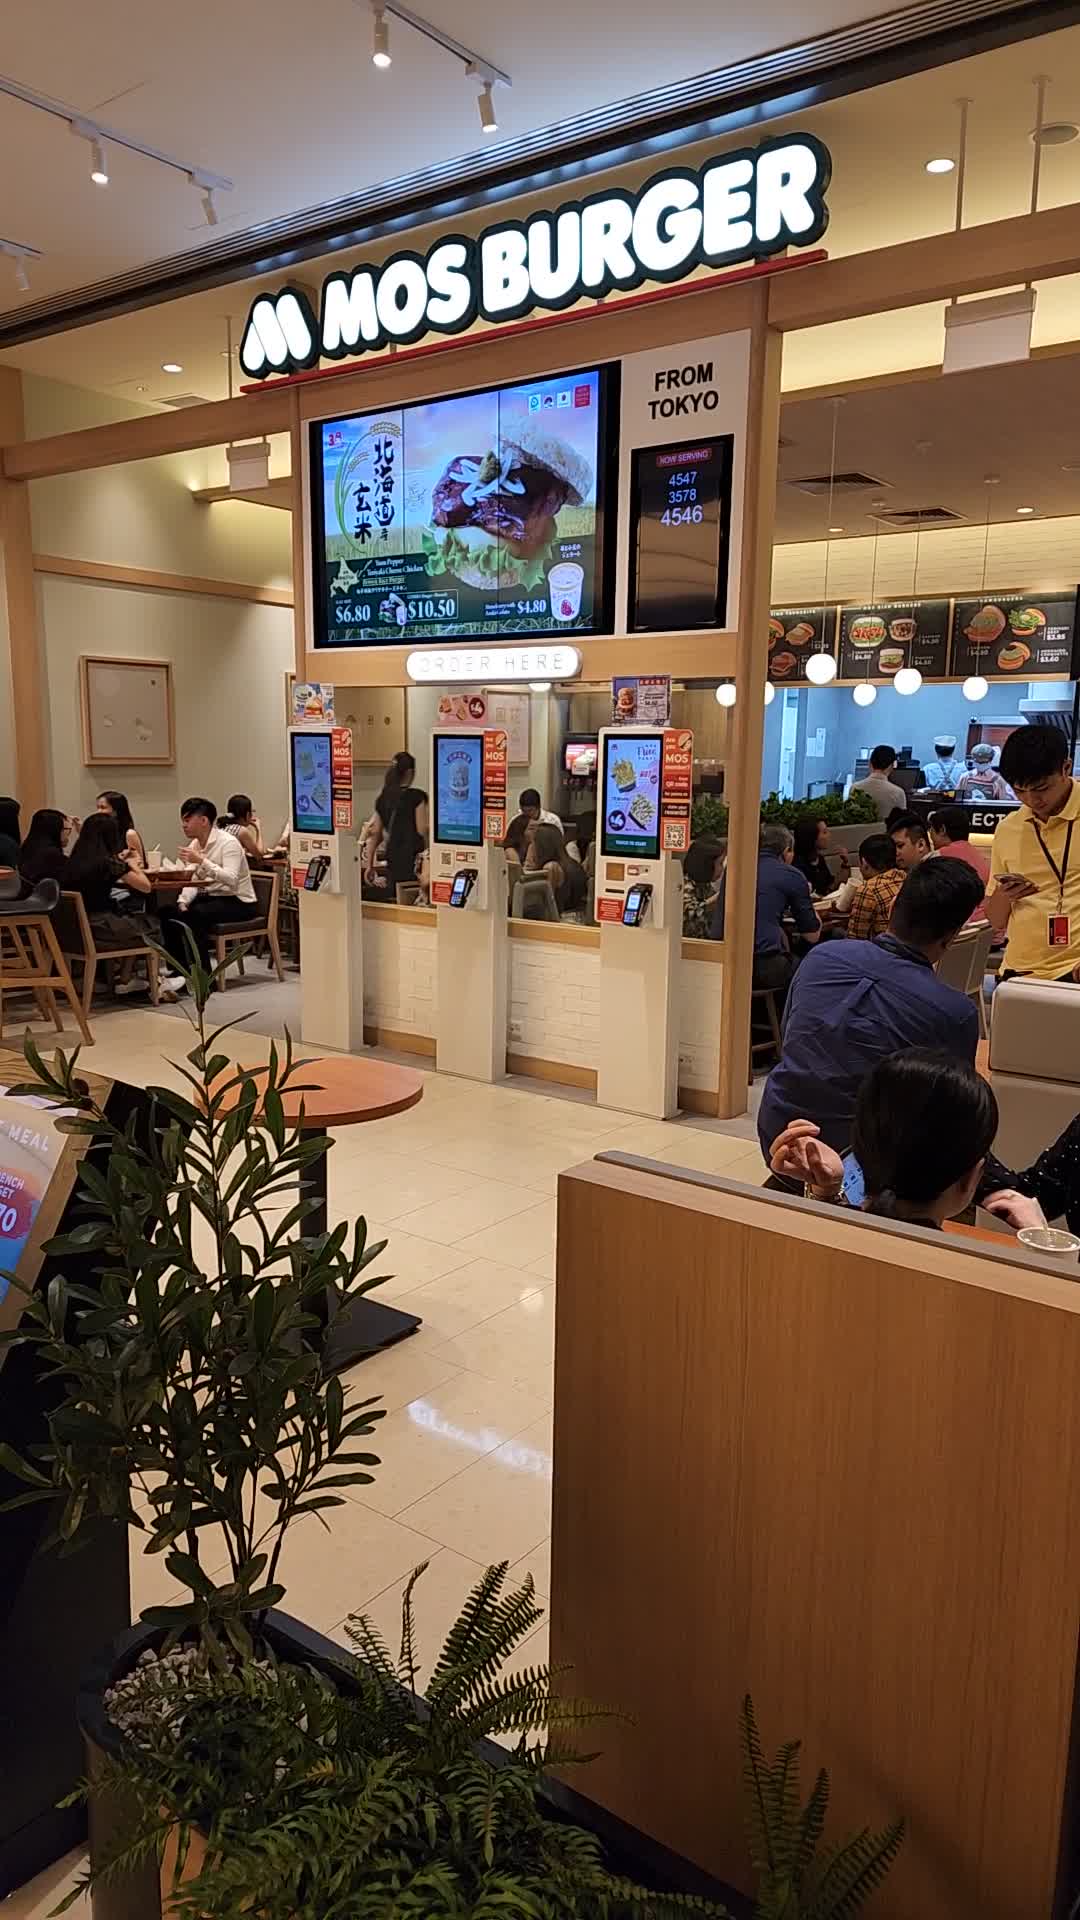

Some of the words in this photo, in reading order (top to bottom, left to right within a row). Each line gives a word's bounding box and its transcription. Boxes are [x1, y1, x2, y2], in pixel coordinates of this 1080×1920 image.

[322, 242, 468, 351] MOS
[481, 144, 818, 312] BURGER
[655, 362, 714, 392] FROM
[648, 390, 719, 420] TOKYO
[668, 471, 697, 487] 4547
[668, 488, 697, 504] 3578
[352, 482, 373, 544] 玄米
[660, 505, 703, 527] 4546
[336, 604, 371, 624] $6.80
[408, 599, 455, 619] $10.50
[517, 599, 546, 615] $4.80
[419, 656, 490, 673] ORDER
[505, 653, 562, 673] HERE
[333, 747, 350, 756] MOS
[485, 751, 505, 761] MOS
[665, 753, 689, 764] MOS
[8, 1123, 49, 1152] MEAL
[0, 1172, 25, 1190] ENCH
[0, 1202, 17, 1232] 70
